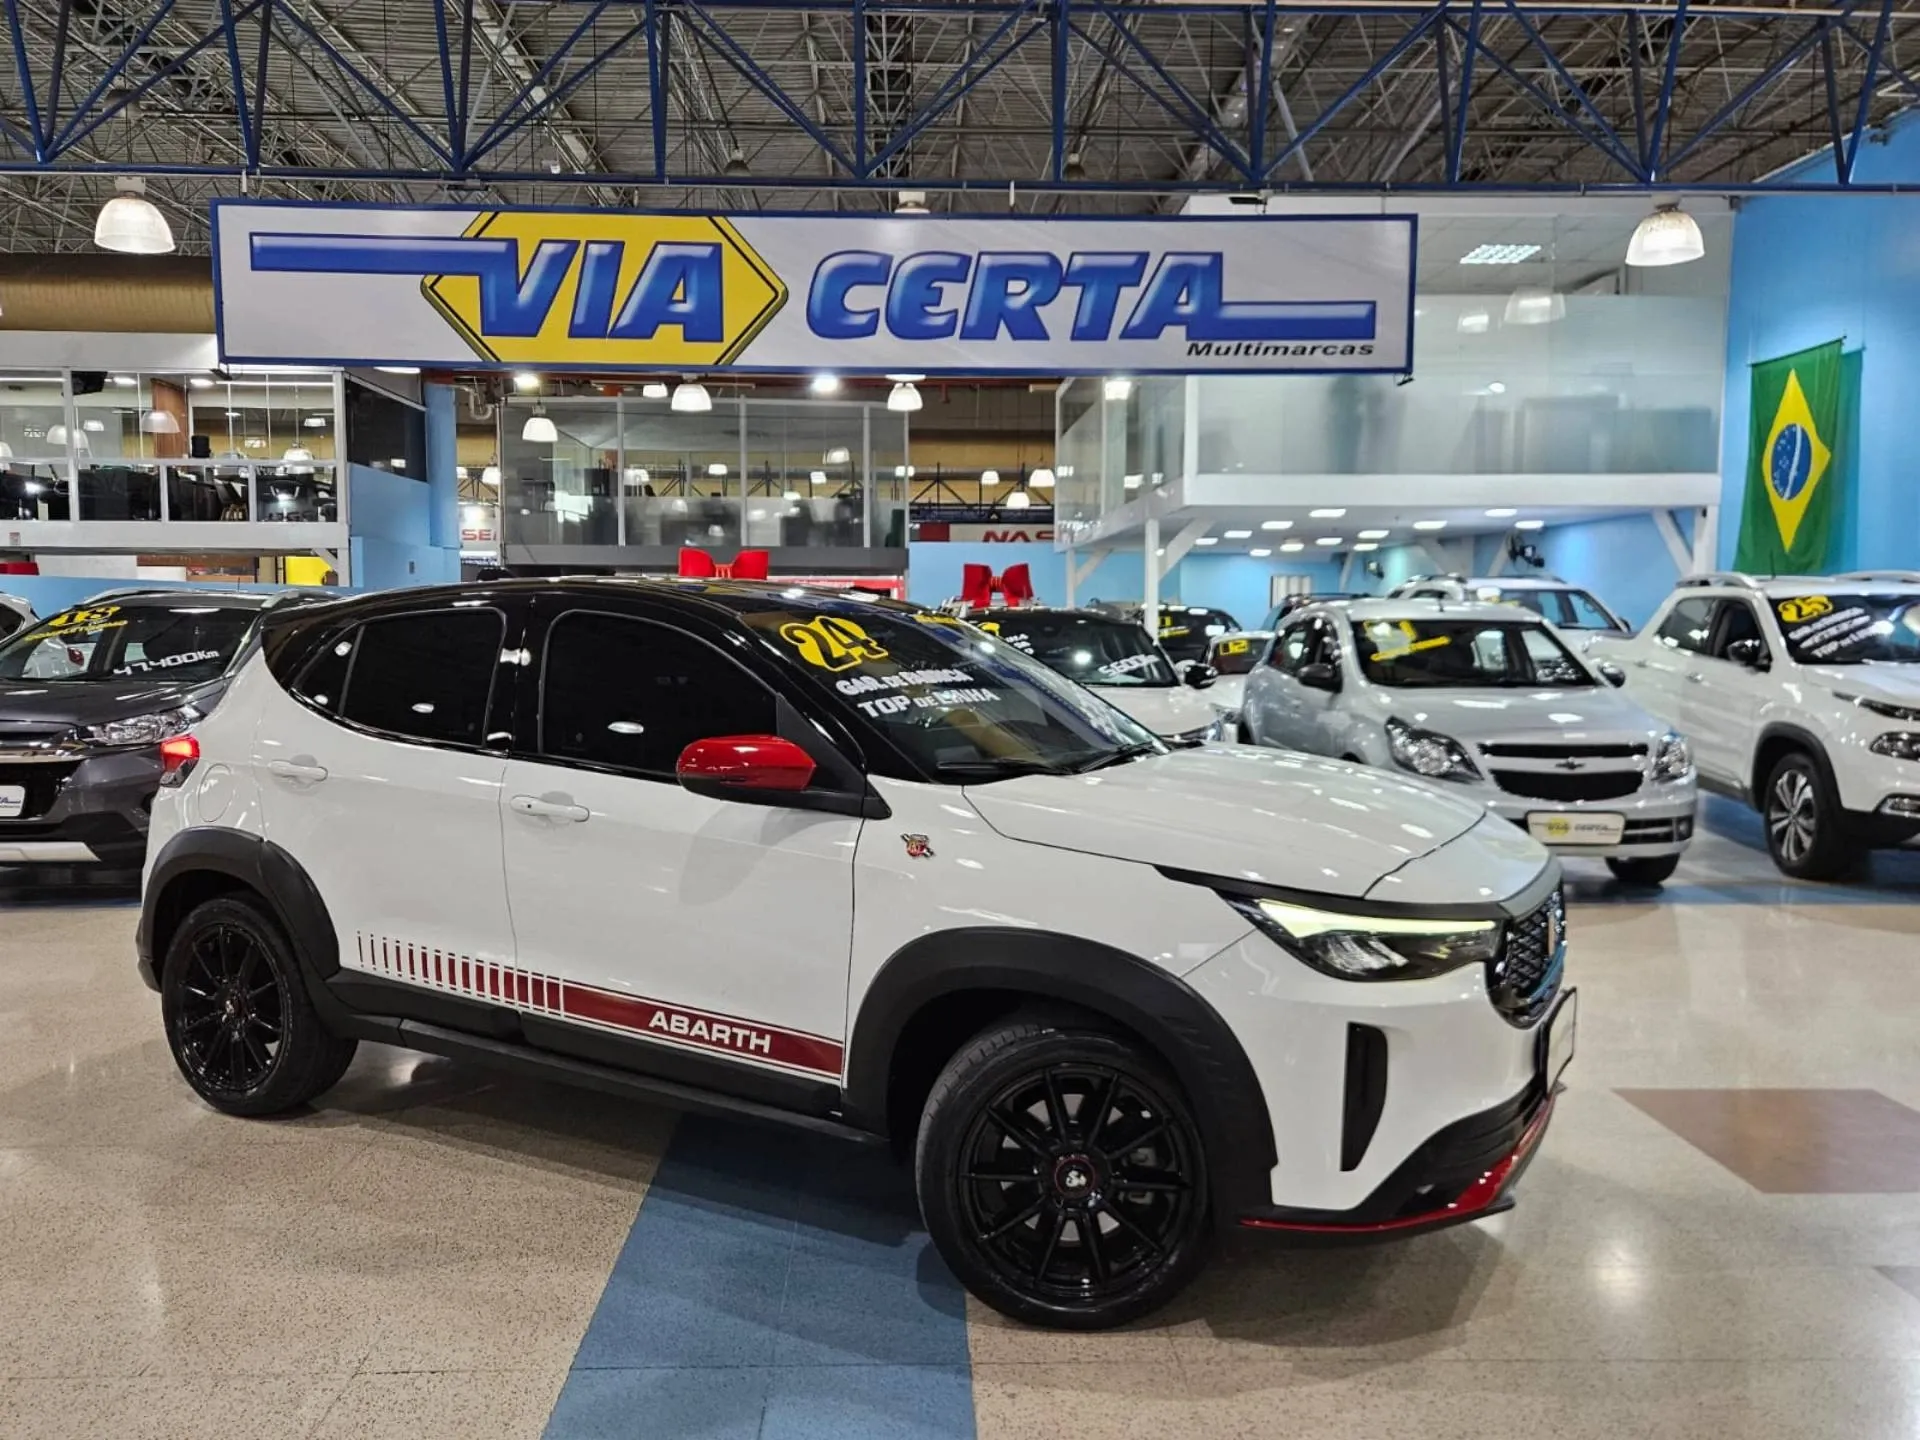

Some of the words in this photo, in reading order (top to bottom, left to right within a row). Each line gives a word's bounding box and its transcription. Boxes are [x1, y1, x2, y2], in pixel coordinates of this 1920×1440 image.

[478, 238, 725, 343] VIA
[805, 250, 1224, 341] CERTA
[1187, 342, 1374, 357] Multimarcas
[461, 528, 497, 541] SE
[779, 615, 889, 672] 24
[857, 695, 911, 718] TOP
[913, 692, 939, 708] DE
[648, 1010, 771, 1054] ABARTH
